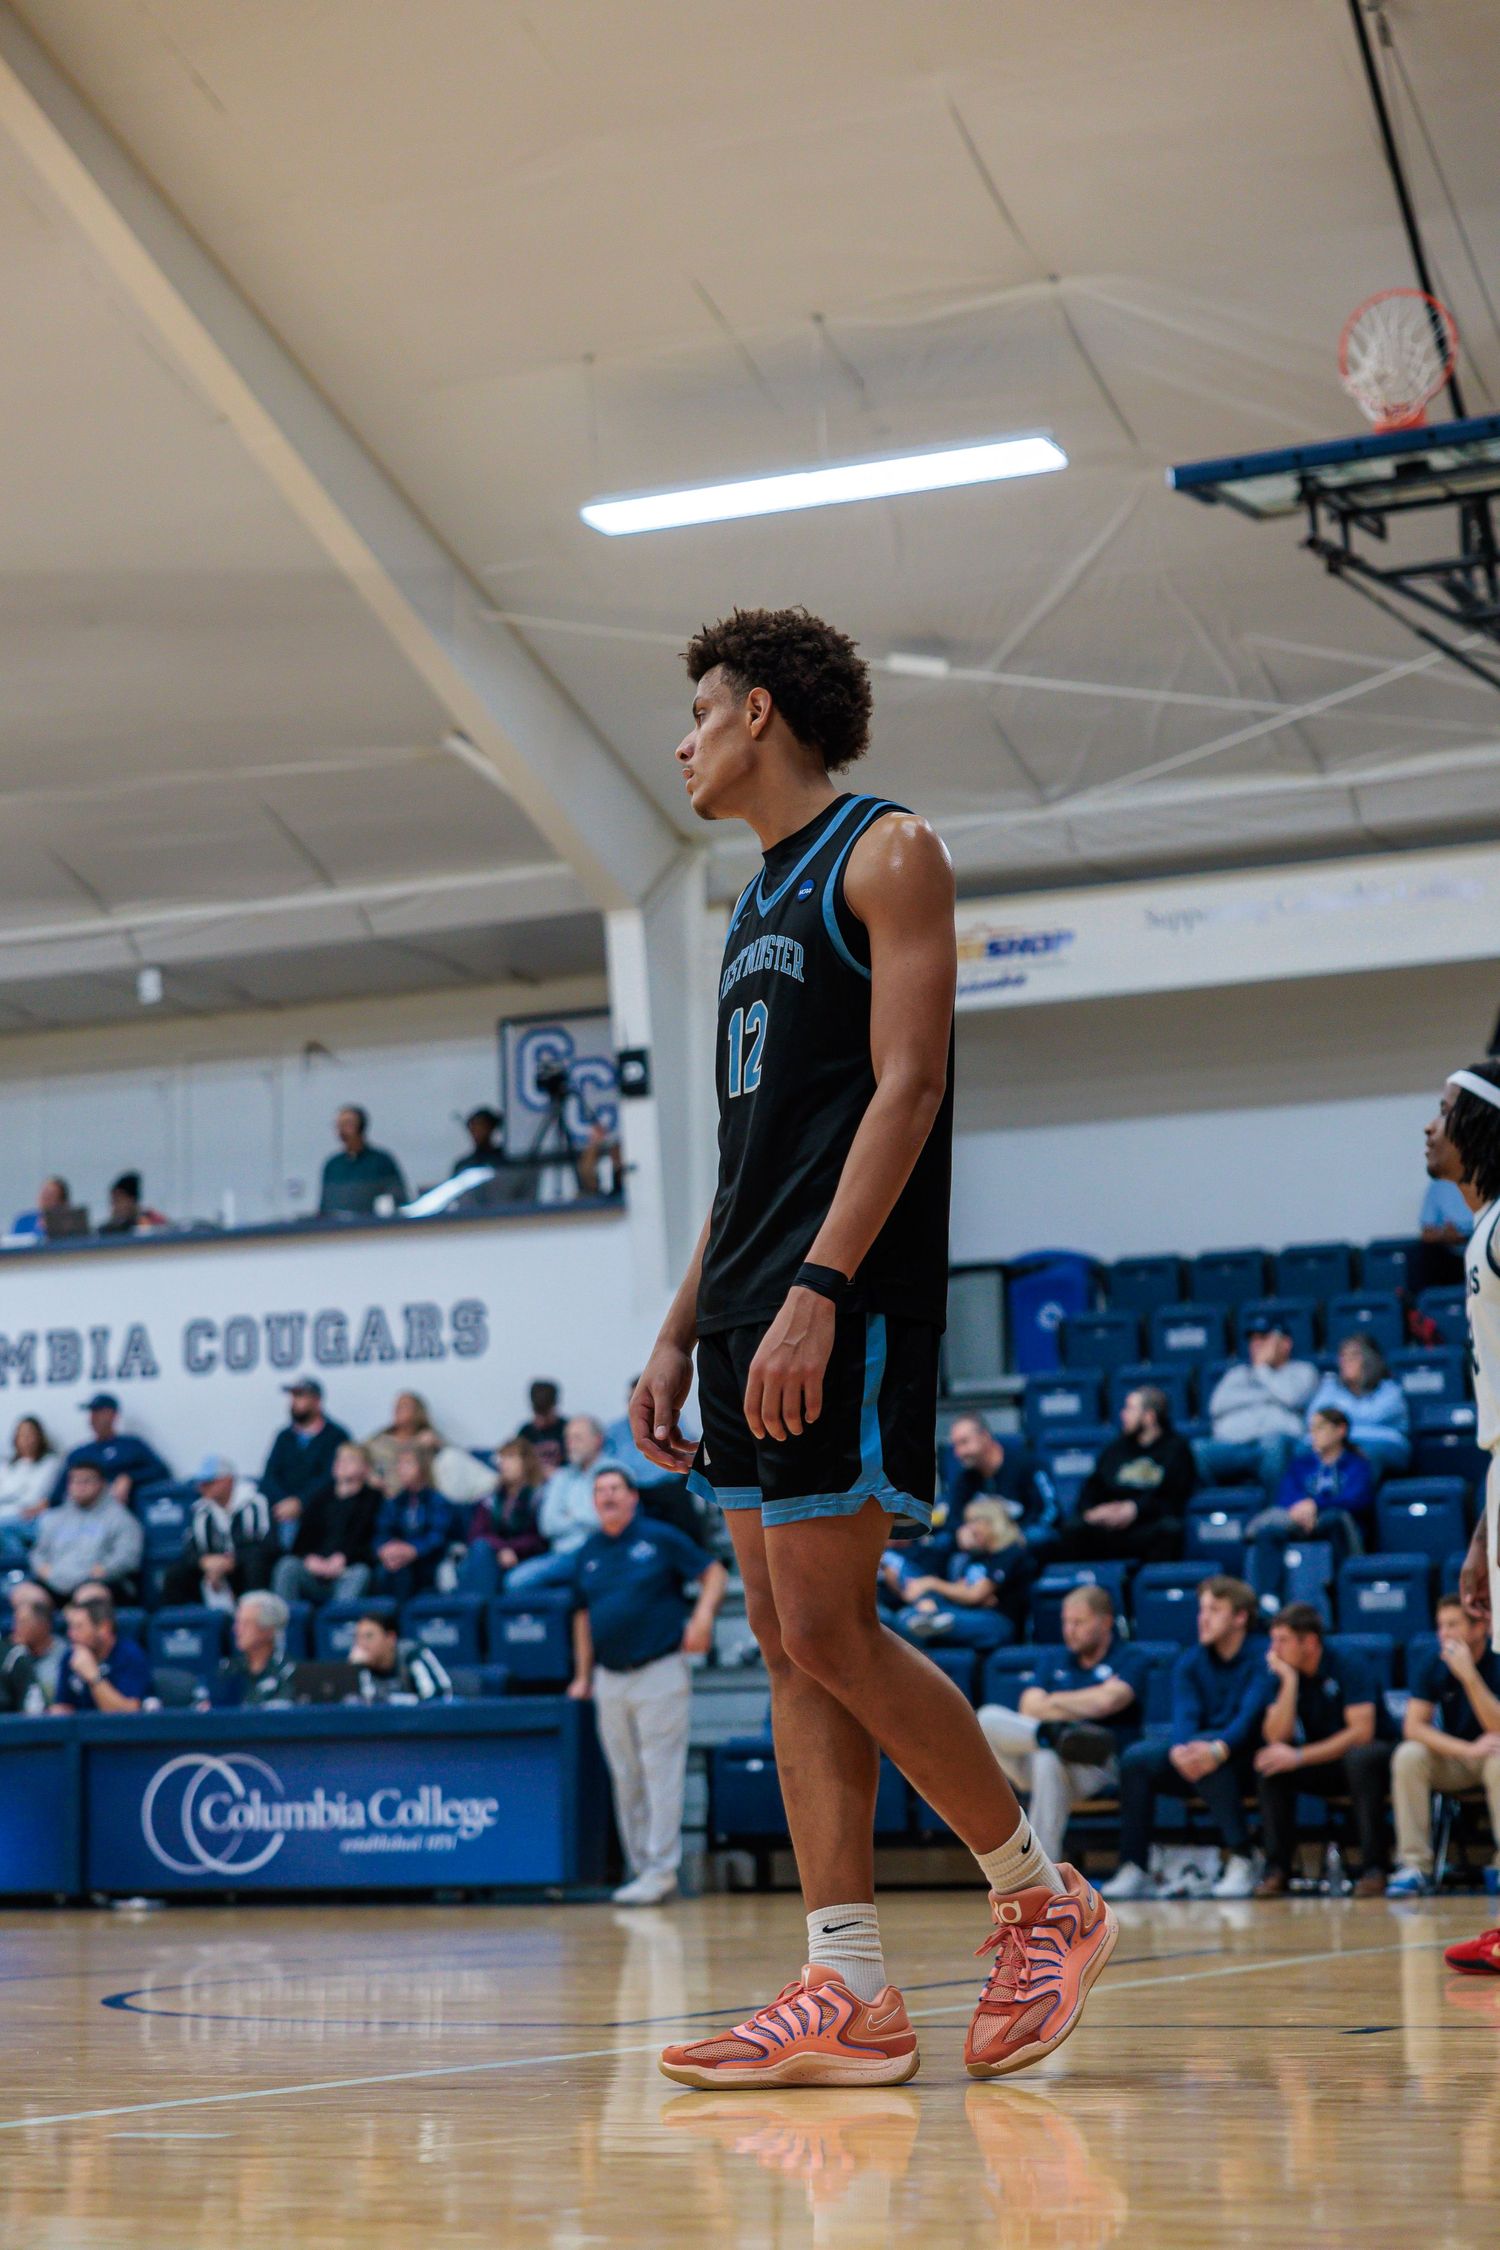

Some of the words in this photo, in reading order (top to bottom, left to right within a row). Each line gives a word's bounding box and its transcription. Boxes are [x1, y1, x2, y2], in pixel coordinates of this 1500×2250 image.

[727, 999, 769, 1099] 12
[183, 1298, 489, 1375] COUGARS
[199, 1787, 367, 1834] Columbia
[367, 1784, 499, 1841] College
